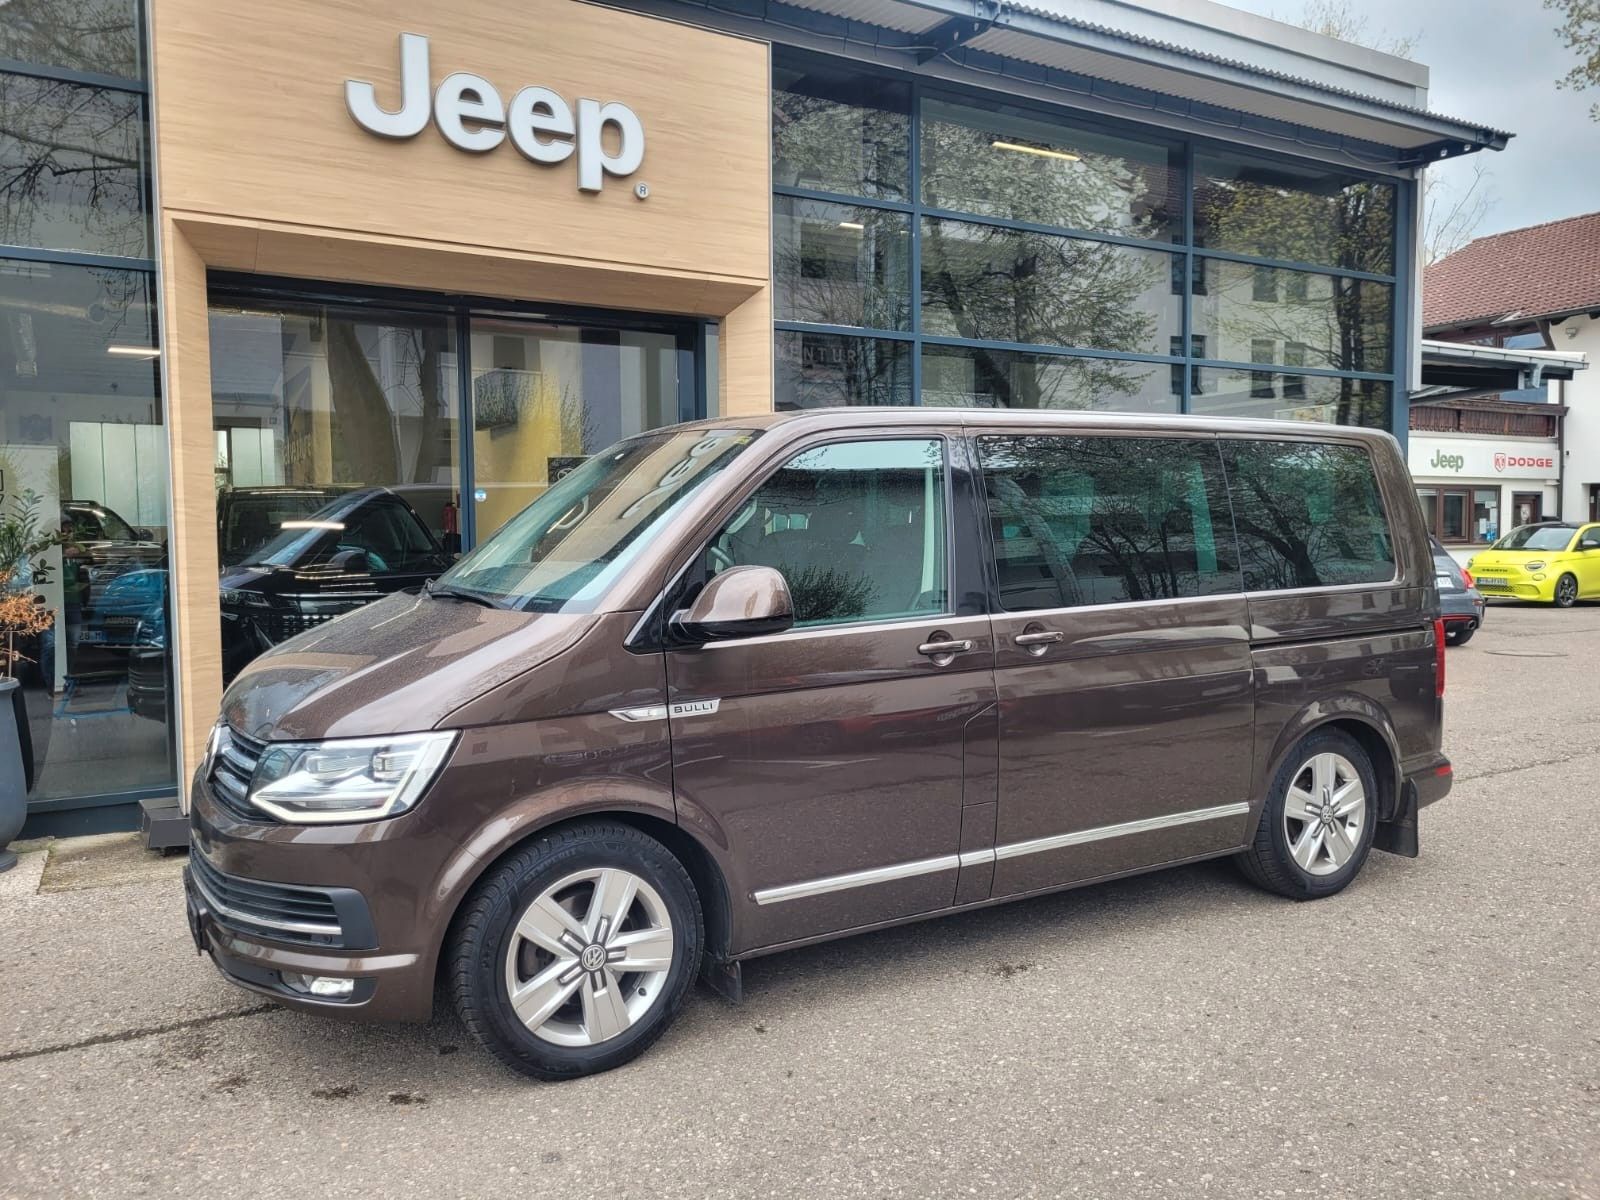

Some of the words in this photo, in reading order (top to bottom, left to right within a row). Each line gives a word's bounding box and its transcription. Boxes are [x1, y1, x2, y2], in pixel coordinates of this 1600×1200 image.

[345, 32, 645, 193] Jeep
[1431, 449, 1464, 472] Jeep
[1508, 457, 1553, 468] DODGE
[674, 702, 713, 713] BULLI
